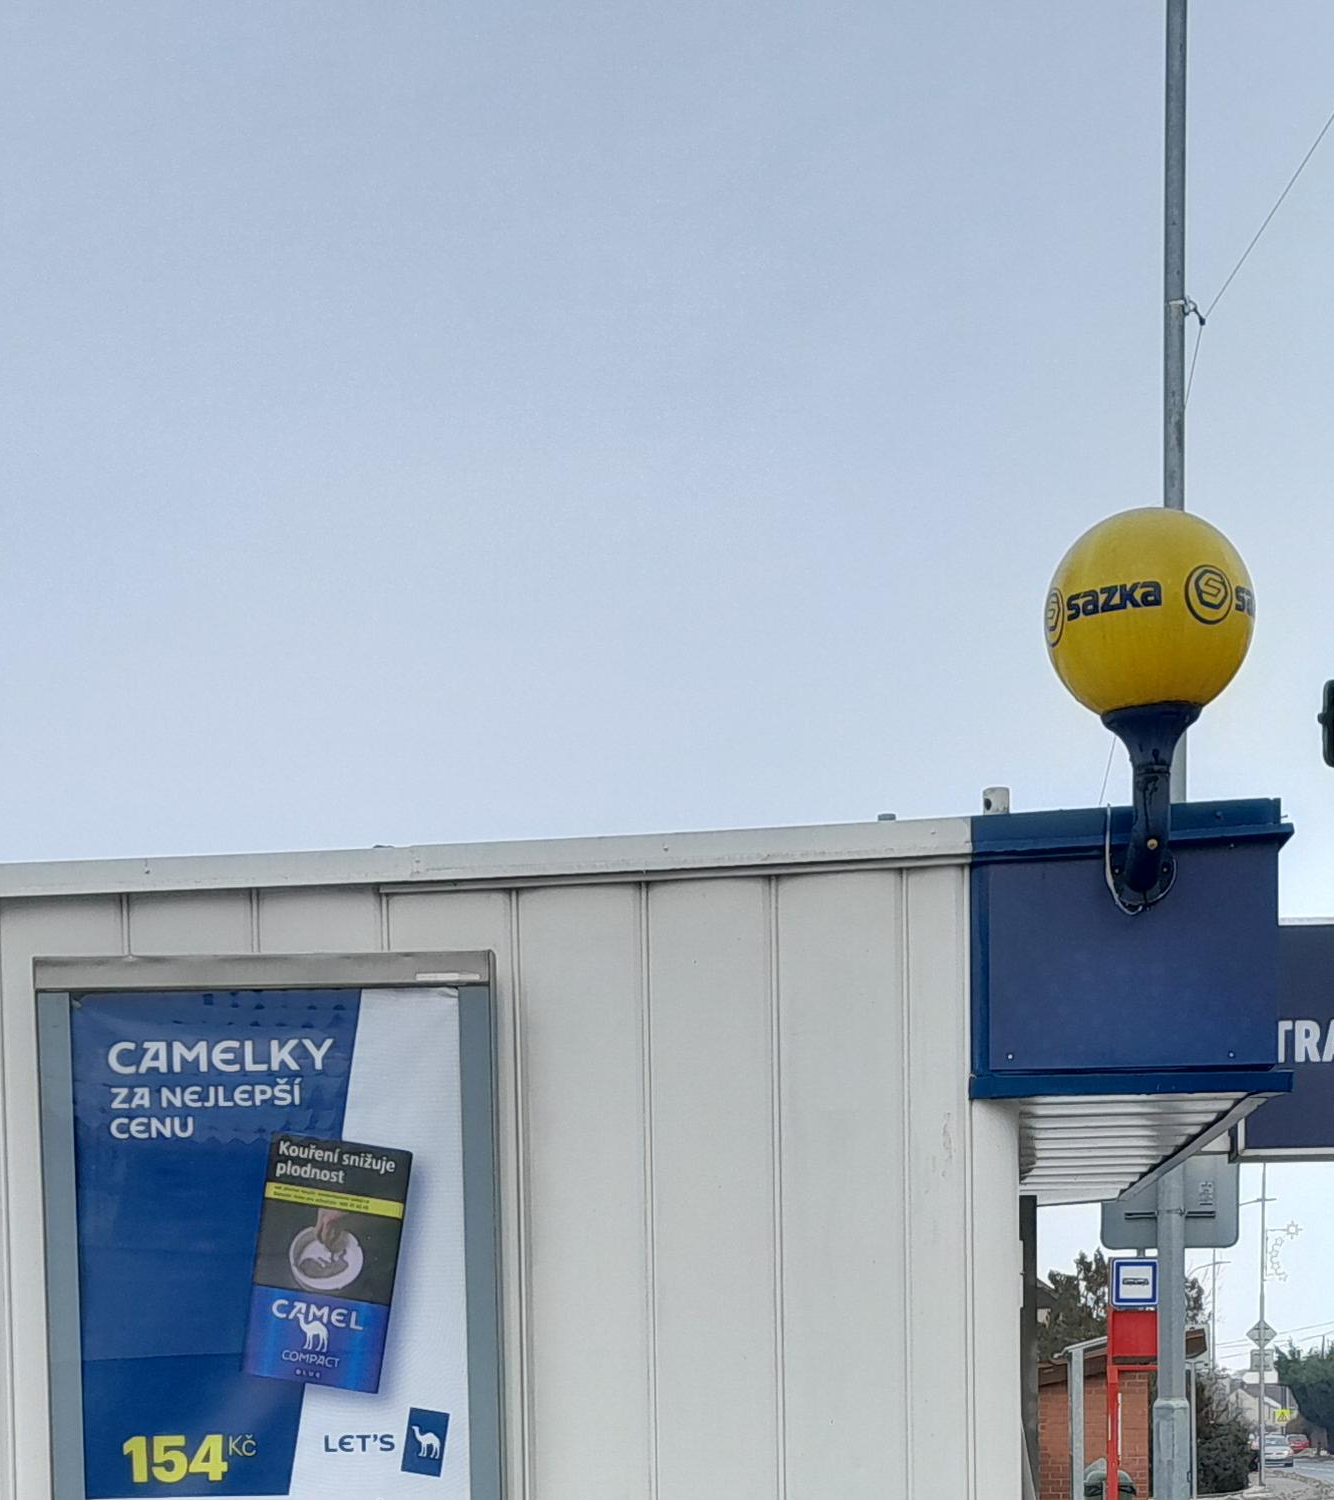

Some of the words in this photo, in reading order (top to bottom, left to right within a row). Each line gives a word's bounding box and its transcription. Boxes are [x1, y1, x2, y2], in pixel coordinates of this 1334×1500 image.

[107, 1038, 335, 1074] CAMELKY
[111, 1087, 151, 1109] ZA
[161, 1078, 302, 1108] NEJLEPŠÍ
[110, 1116, 194, 1139] CENU
[275, 1160, 345, 1183] plodnost
[279, 1140, 339, 1163] Kouření
[342, 1152, 396, 1174] snižuje
[272, 1299, 363, 1330] CAMEL
[281, 1349, 340, 1368] COMPACT
[122, 1434, 228, 1483] 154
[324, 1434, 395, 1452] LET'S
